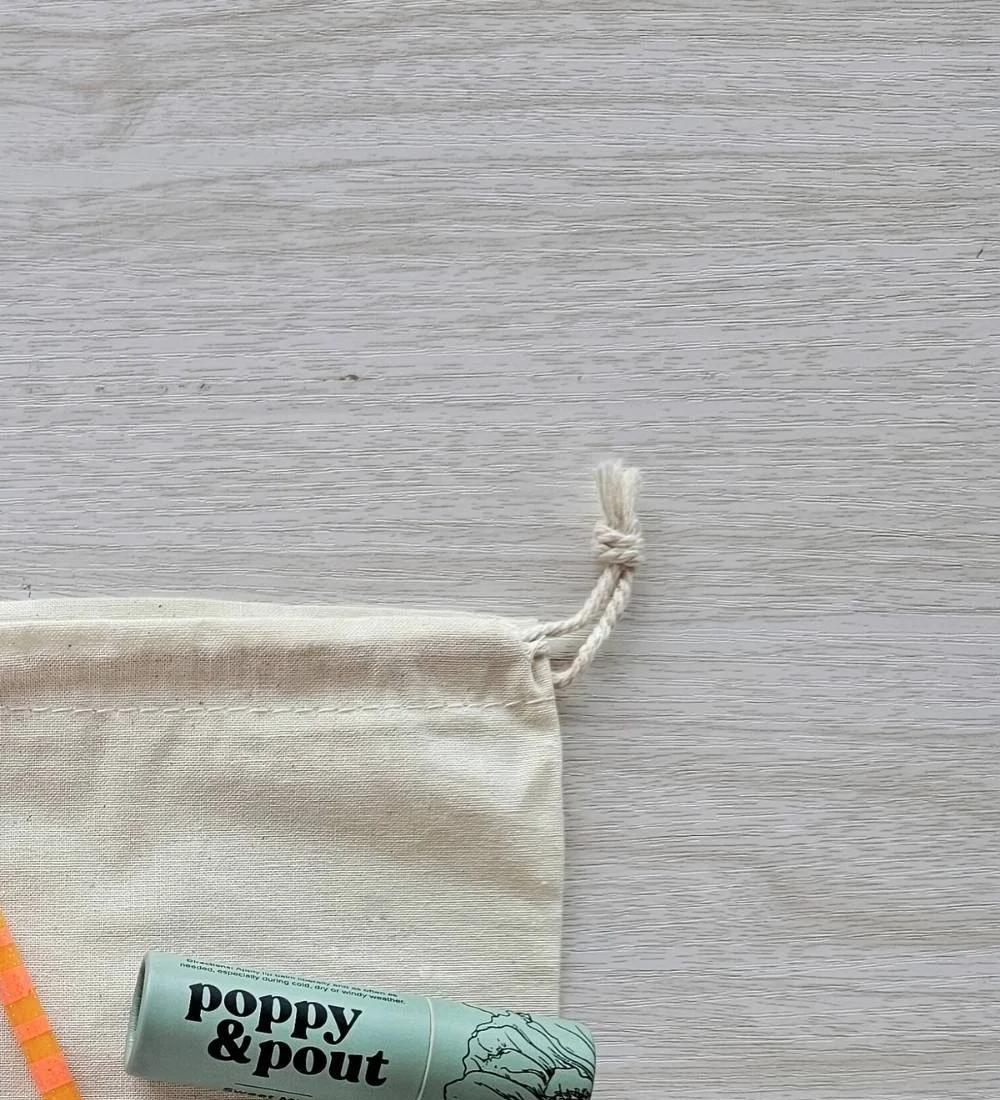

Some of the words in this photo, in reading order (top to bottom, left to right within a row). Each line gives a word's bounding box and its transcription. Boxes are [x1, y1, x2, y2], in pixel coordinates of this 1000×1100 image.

[185, 984, 362, 1044] poppy
[261, 975, 290, 987] during
[313, 983, 330, 993] dry
[208, 1019, 389, 1086] &pout
